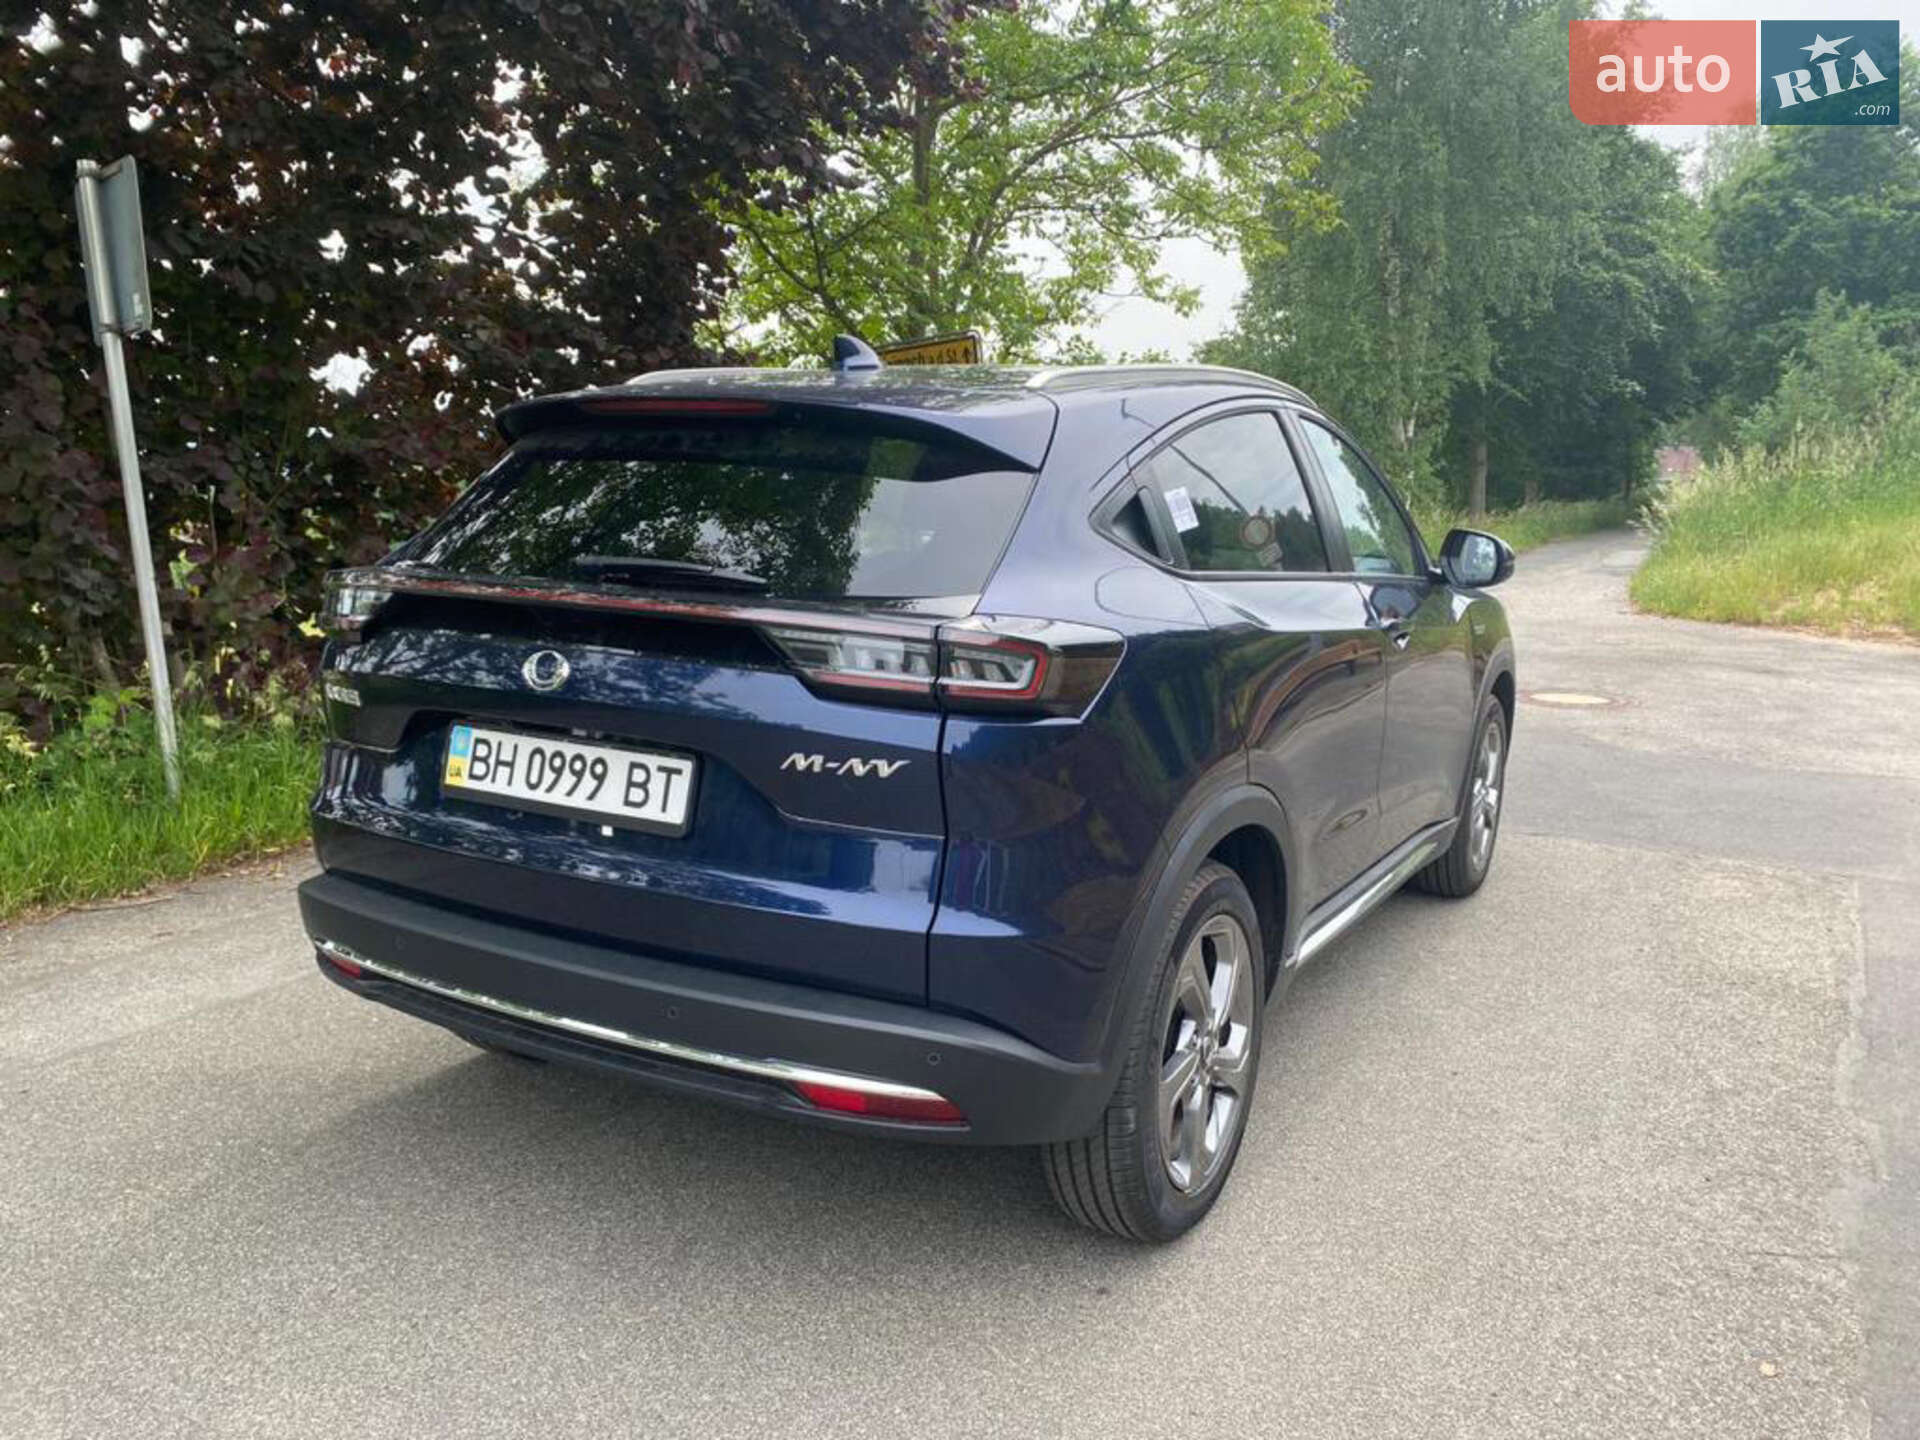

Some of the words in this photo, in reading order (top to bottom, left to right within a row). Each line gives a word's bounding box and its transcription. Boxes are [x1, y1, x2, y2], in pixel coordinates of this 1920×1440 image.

[468, 737, 518, 787] BH
[525, 746, 608, 801] 0999
[623, 760, 683, 813] BT
[780, 752, 912, 778] M-NV
